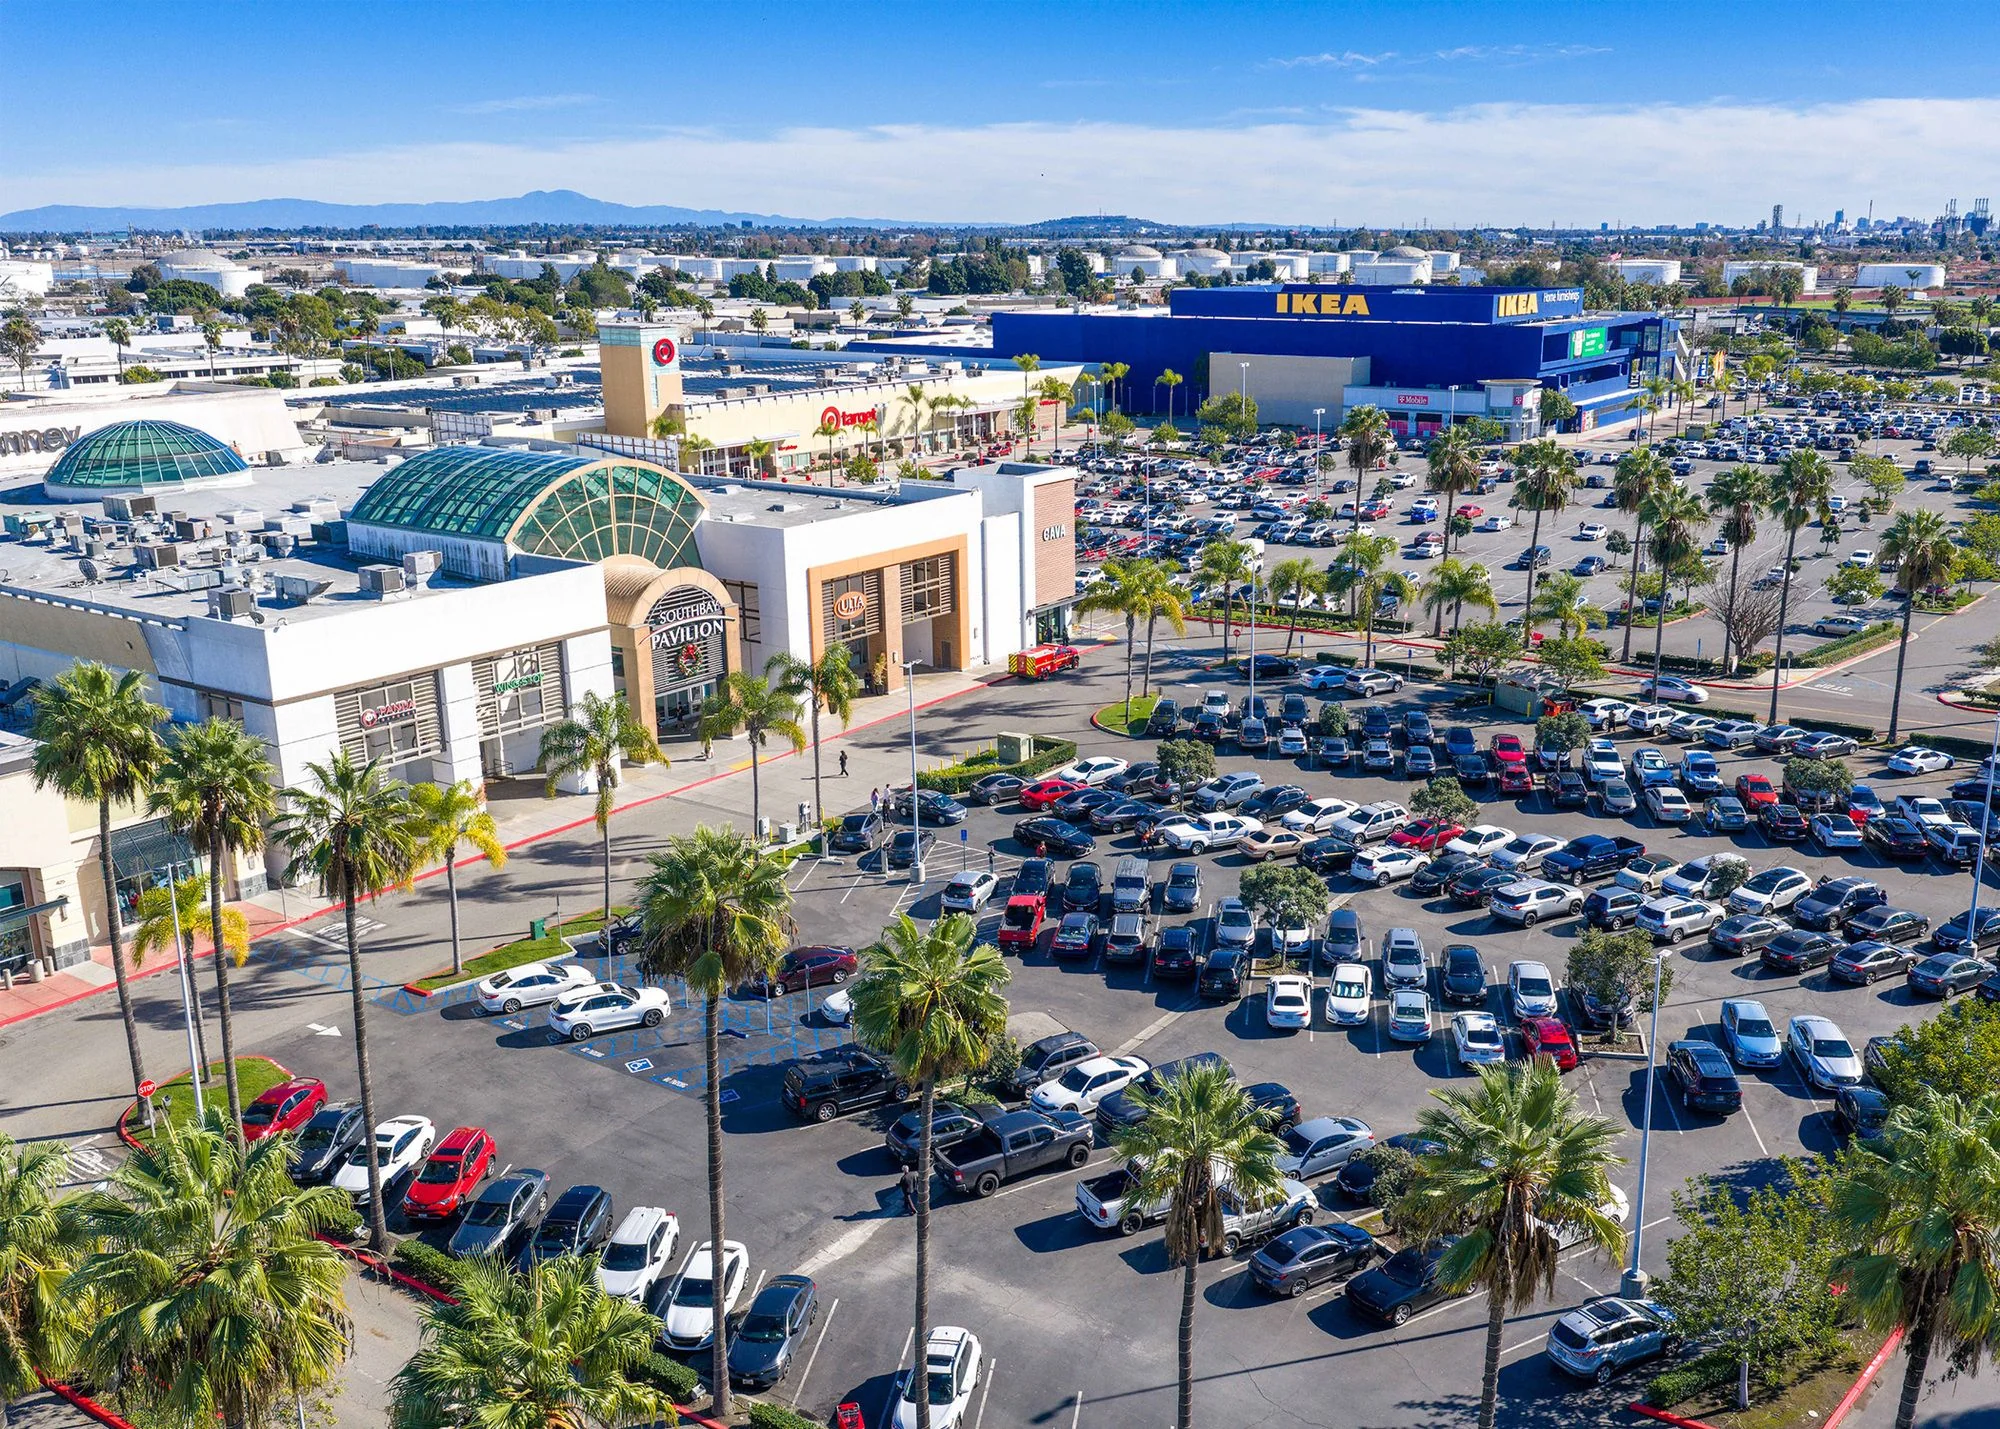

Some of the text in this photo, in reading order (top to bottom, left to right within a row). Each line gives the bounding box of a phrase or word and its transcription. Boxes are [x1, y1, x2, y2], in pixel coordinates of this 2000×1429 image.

[1276, 293, 1370, 315] IKEA
[1498, 293, 1538, 317] IKEA
[1544, 290, 1580, 304] Home furnishings
[841, 408, 877, 427] target
[1043, 524, 1066, 541] CAVA
[841, 595, 865, 612] ULTA
[652, 619, 724, 650] PAVILION
[379, 700, 416, 715] PANDA
[139, 1083, 155, 1094] STOP
